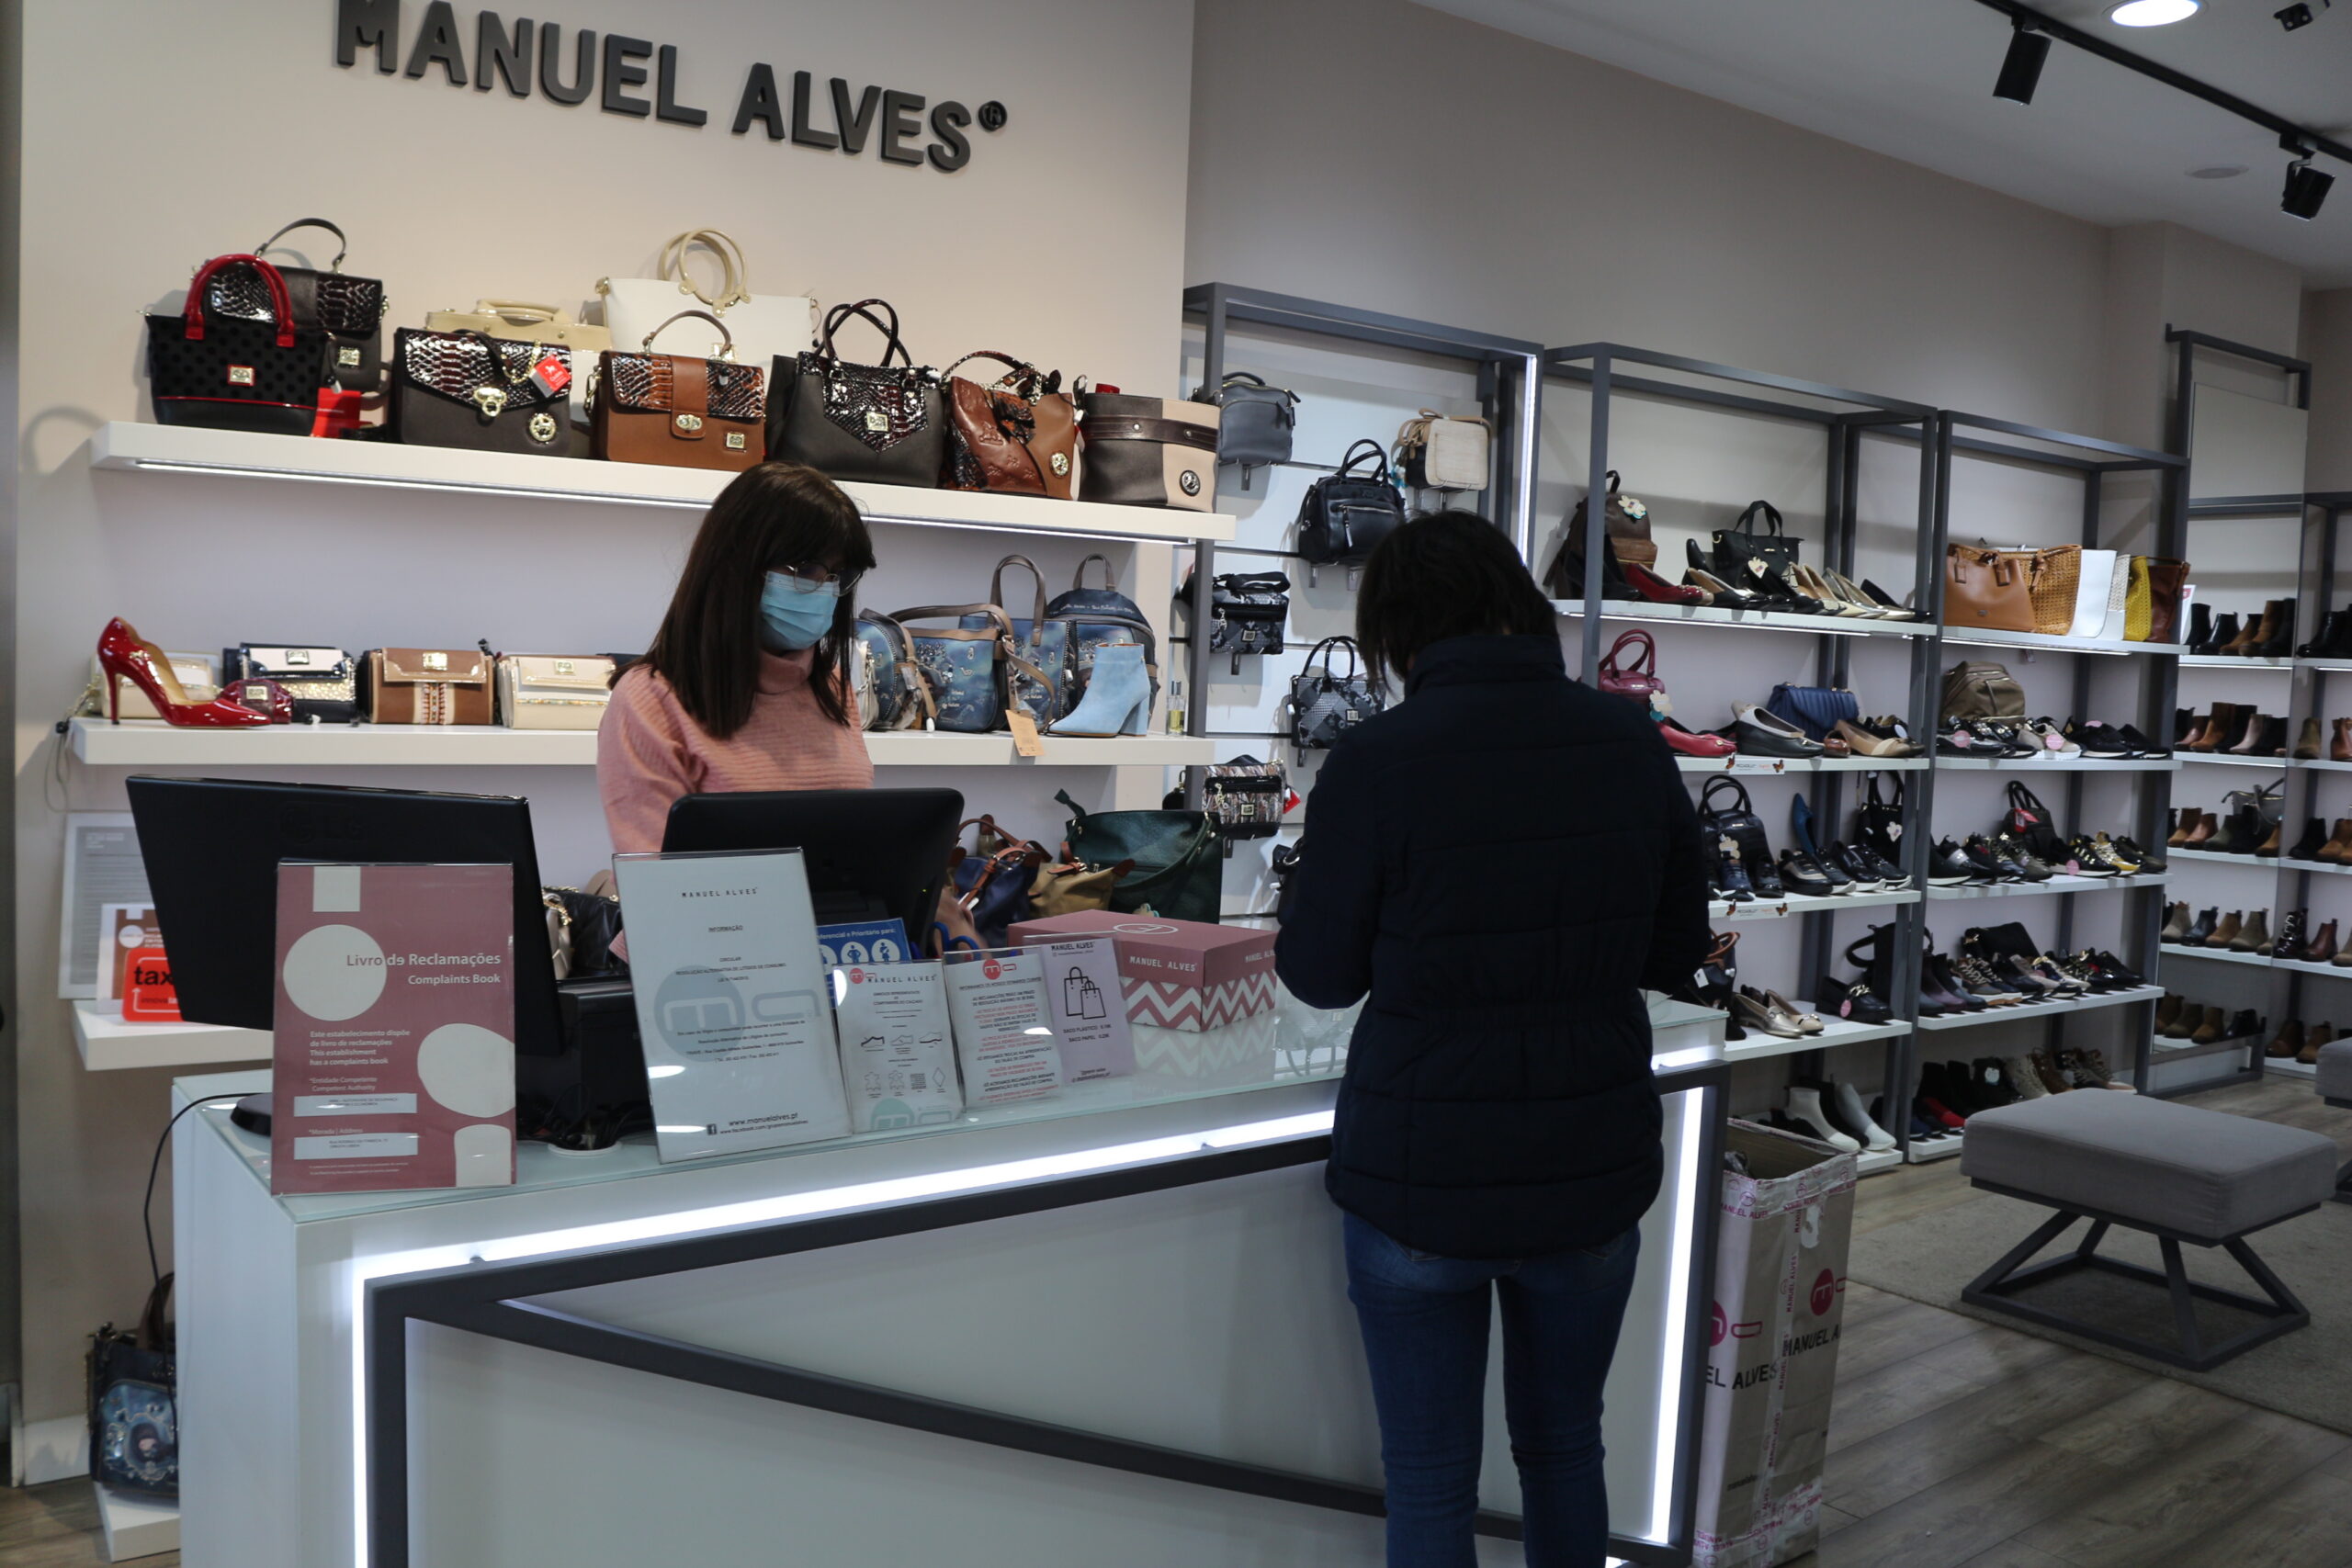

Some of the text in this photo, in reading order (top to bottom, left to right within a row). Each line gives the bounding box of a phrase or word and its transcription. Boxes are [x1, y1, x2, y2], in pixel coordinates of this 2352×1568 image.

[337, 0, 707, 126] MANUEL
[1051, 942, 1075, 951] MANUEL
[346, 953, 501, 967] Livro de Reclamações
[1129, 955, 1196, 971] MANUEL ALVES
[408, 974, 500, 986] Complaints Book
[1782, 1328, 1829, 1357] MANUEL
[1732, 1362, 1777, 1390] ALVES
